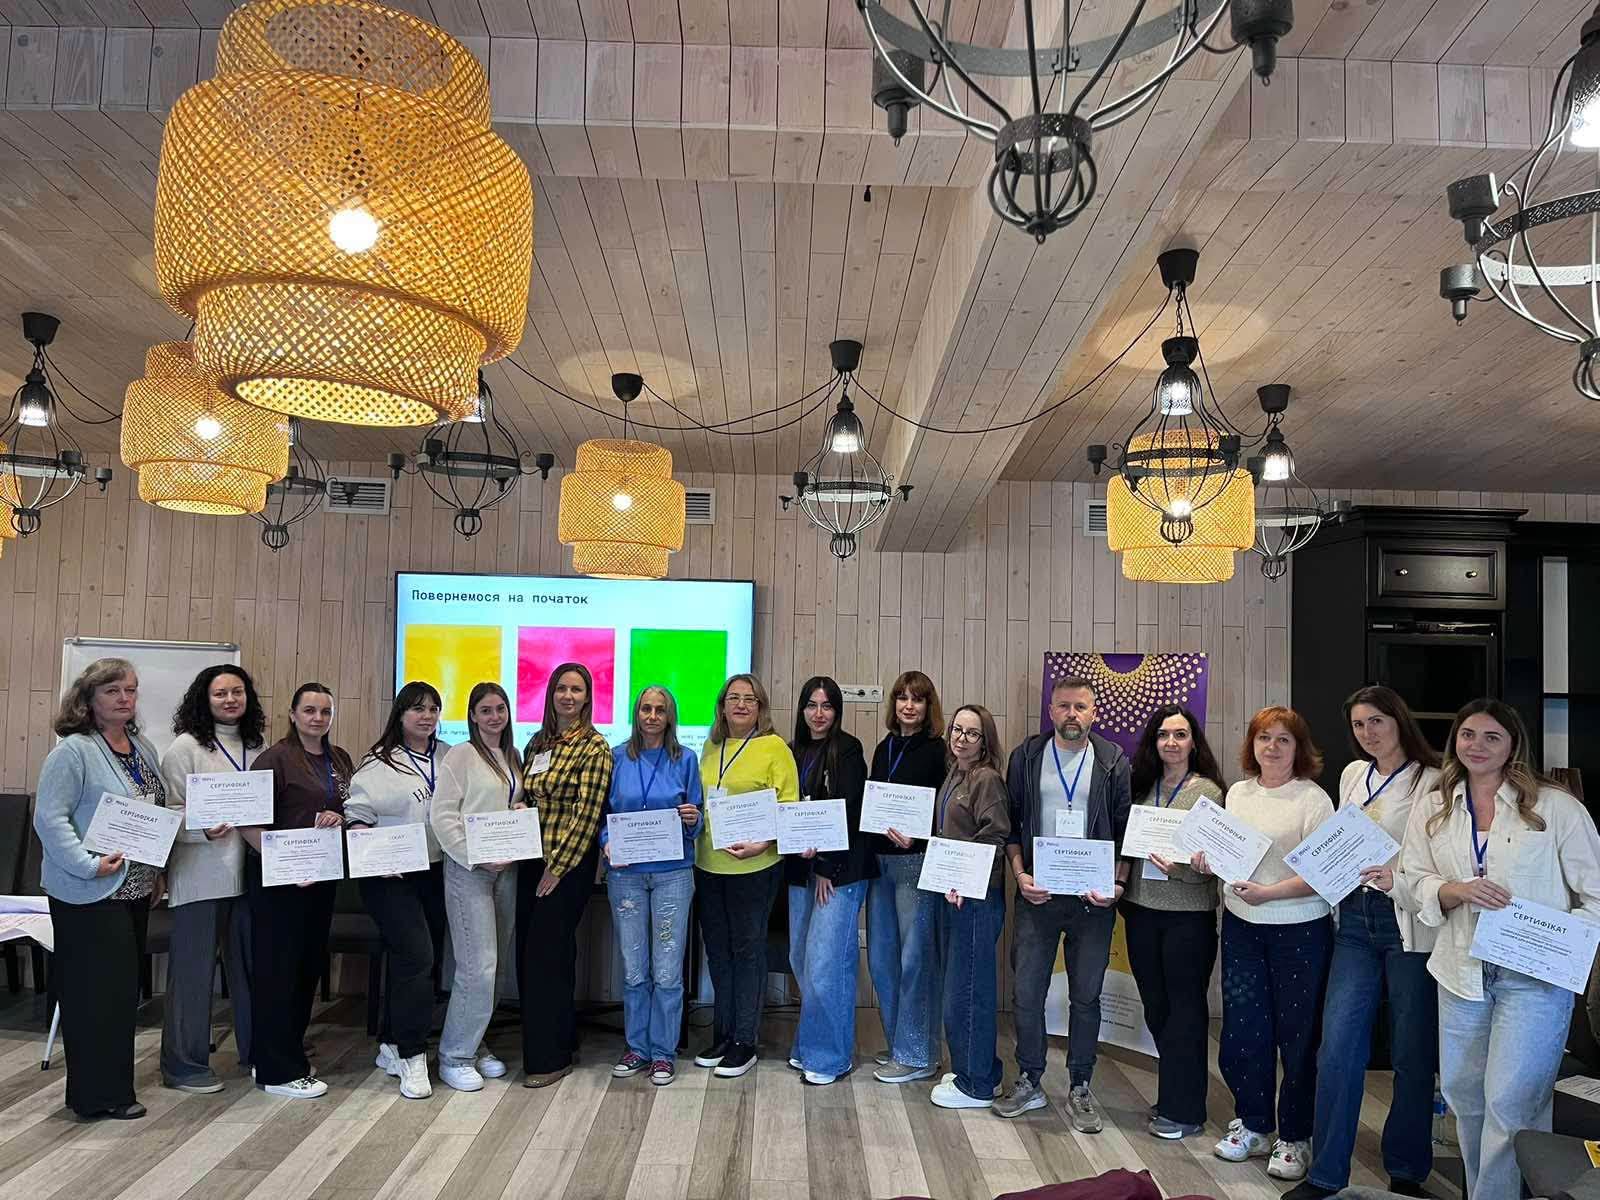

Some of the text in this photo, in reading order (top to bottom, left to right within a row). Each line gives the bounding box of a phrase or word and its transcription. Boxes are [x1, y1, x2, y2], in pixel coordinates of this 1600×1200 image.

[412, 589, 588, 604] Повернемося на початок
[120, 809, 159, 823] СЕРТИФІКАТ
[627, 820, 662, 828] СЕРТИФІКАТ
[1211, 817, 1247, 842] СЕРТИФІКАТ
[283, 838, 320, 846] СЕРТИФІКАТ
[1311, 827, 1345, 857] СЕРТИФІКАТ
[1513, 912, 1567, 934] СЕРТИФІКАТ
